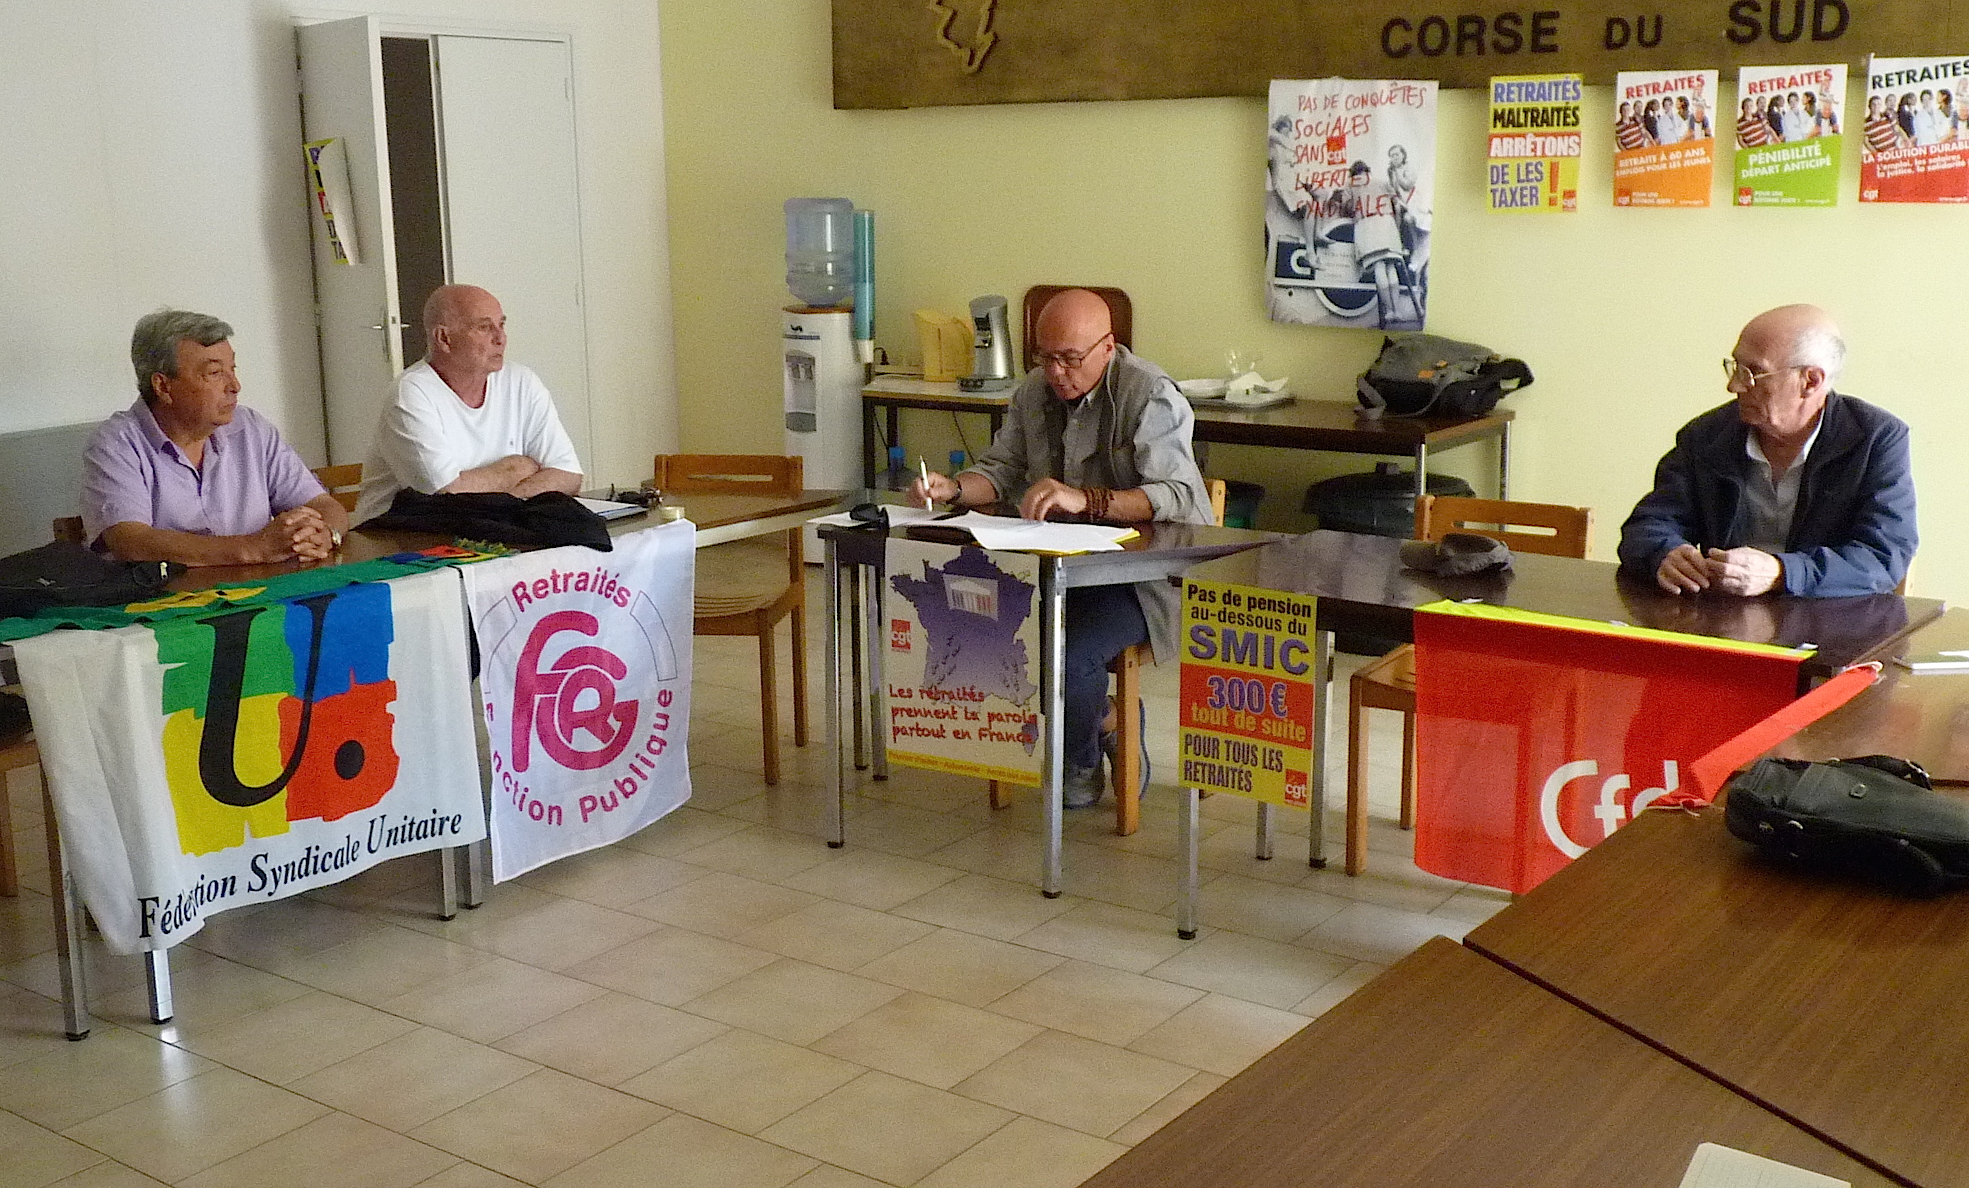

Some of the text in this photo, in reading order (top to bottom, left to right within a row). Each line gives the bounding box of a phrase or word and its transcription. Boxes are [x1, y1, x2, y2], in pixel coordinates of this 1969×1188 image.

[1381, 0, 1850, 59] CORSE DU SUD
[1494, 74, 1581, 102] RETRAITÉS
[1625, 74, 1705, 99] RETRAITES
[1748, 68, 1833, 95] RETRAITES
[1872, 60, 1969, 89] RETRAITES
[1298, 94, 1318, 111] PAS
[1324, 94, 1339, 110] DE
[1493, 101, 1580, 128] MALTRAITÉS
[1295, 144, 1327, 165] SANS
[1490, 133, 1580, 157] ARRÊTONS
[1685, 147, 1706, 157] ANS
[1749, 140, 1822, 165] PÉNIBILITÉ
[1863, 140, 1969, 164] LA SOLUTION DURABL
[1490, 161, 1544, 185] DE LES
[1741, 154, 1832, 178] DÉPART ANTICIPÉ
[1490, 185, 1540, 208] TAXER
[511, 566, 631, 612] Retraités
[1188, 584, 1311, 618] Pas de pension
[1191, 606, 1306, 636] au-dessous du
[1189, 624, 1309, 676] SMIC
[889, 683, 985, 702] Les retraités
[1207, 675, 1288, 719] 300 €
[891, 705, 958, 724] prennent
[1191, 702, 1306, 742] tout de suite
[893, 722, 947, 743] partout
[953, 728, 972, 740] en
[579, 689, 674, 823] Publique
[1184, 733, 1283, 773] POUR TOUS LES
[1184, 760, 1252, 792] RETRAITÉS
[1286, 784, 1306, 798] cgt
[247, 834, 360, 896] Syndicale
[367, 808, 462, 854] Unitaire
